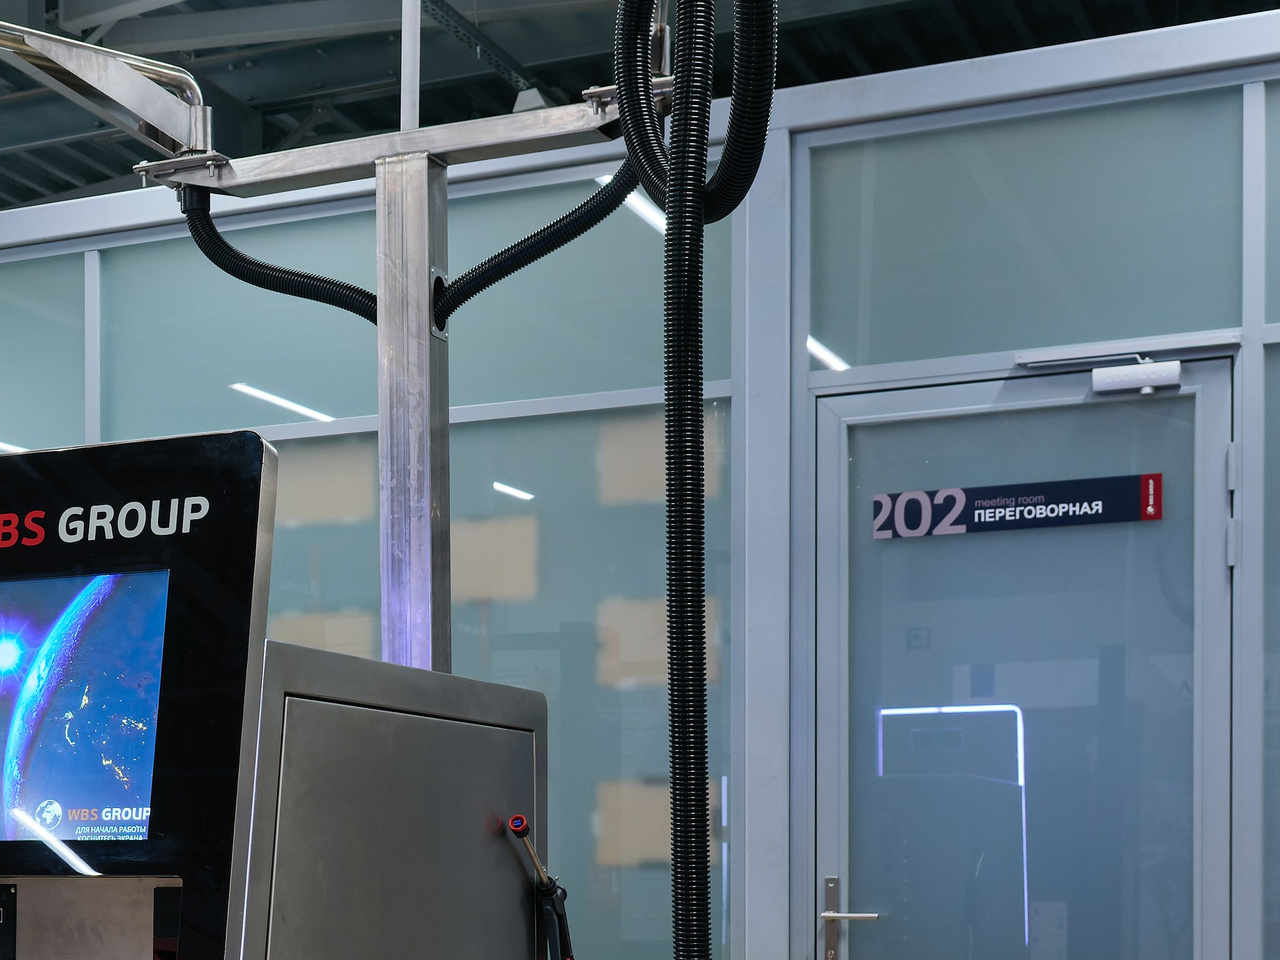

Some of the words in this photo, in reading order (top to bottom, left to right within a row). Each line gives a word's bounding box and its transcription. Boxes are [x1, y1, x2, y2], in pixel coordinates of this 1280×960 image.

[974, 497, 1015, 508] meeting
[1018, 495, 1045, 504] room
[58, 496, 210, 543] GROUP
[873, 487, 966, 539] 202
[974, 501, 1103, 522] ПЕРЕГОВОРНАЯ
[67, 808, 99, 821] WBS
[101, 807, 151, 821] GROUP
[75, 826, 89, 834] ДЛЯ
[90, 825, 118, 834] НАЧАЛА
[118, 825, 146, 833] РАБОТЫ
